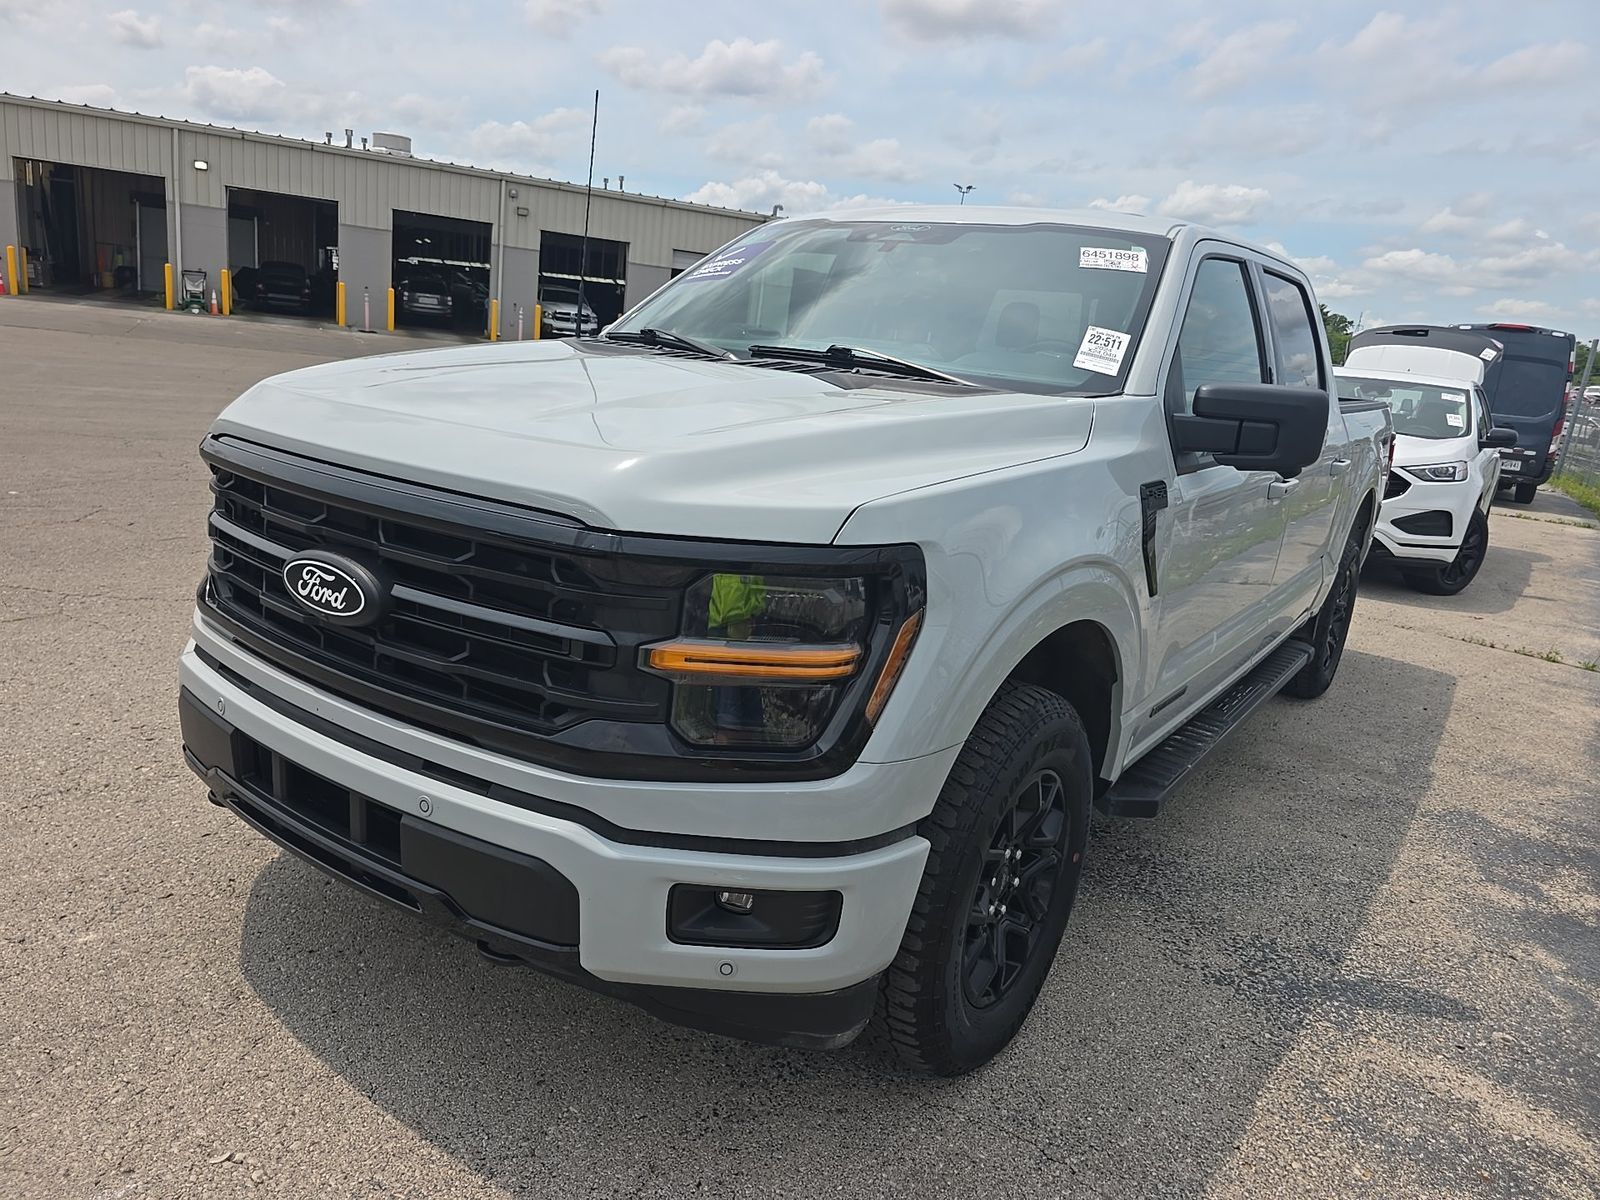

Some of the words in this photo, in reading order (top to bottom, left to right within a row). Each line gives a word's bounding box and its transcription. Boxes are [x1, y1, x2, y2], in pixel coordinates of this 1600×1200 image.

[1082, 250, 1139, 262] 6451898
[1088, 334, 1122, 350] 22:511
[298, 566, 348, 610] Ford
